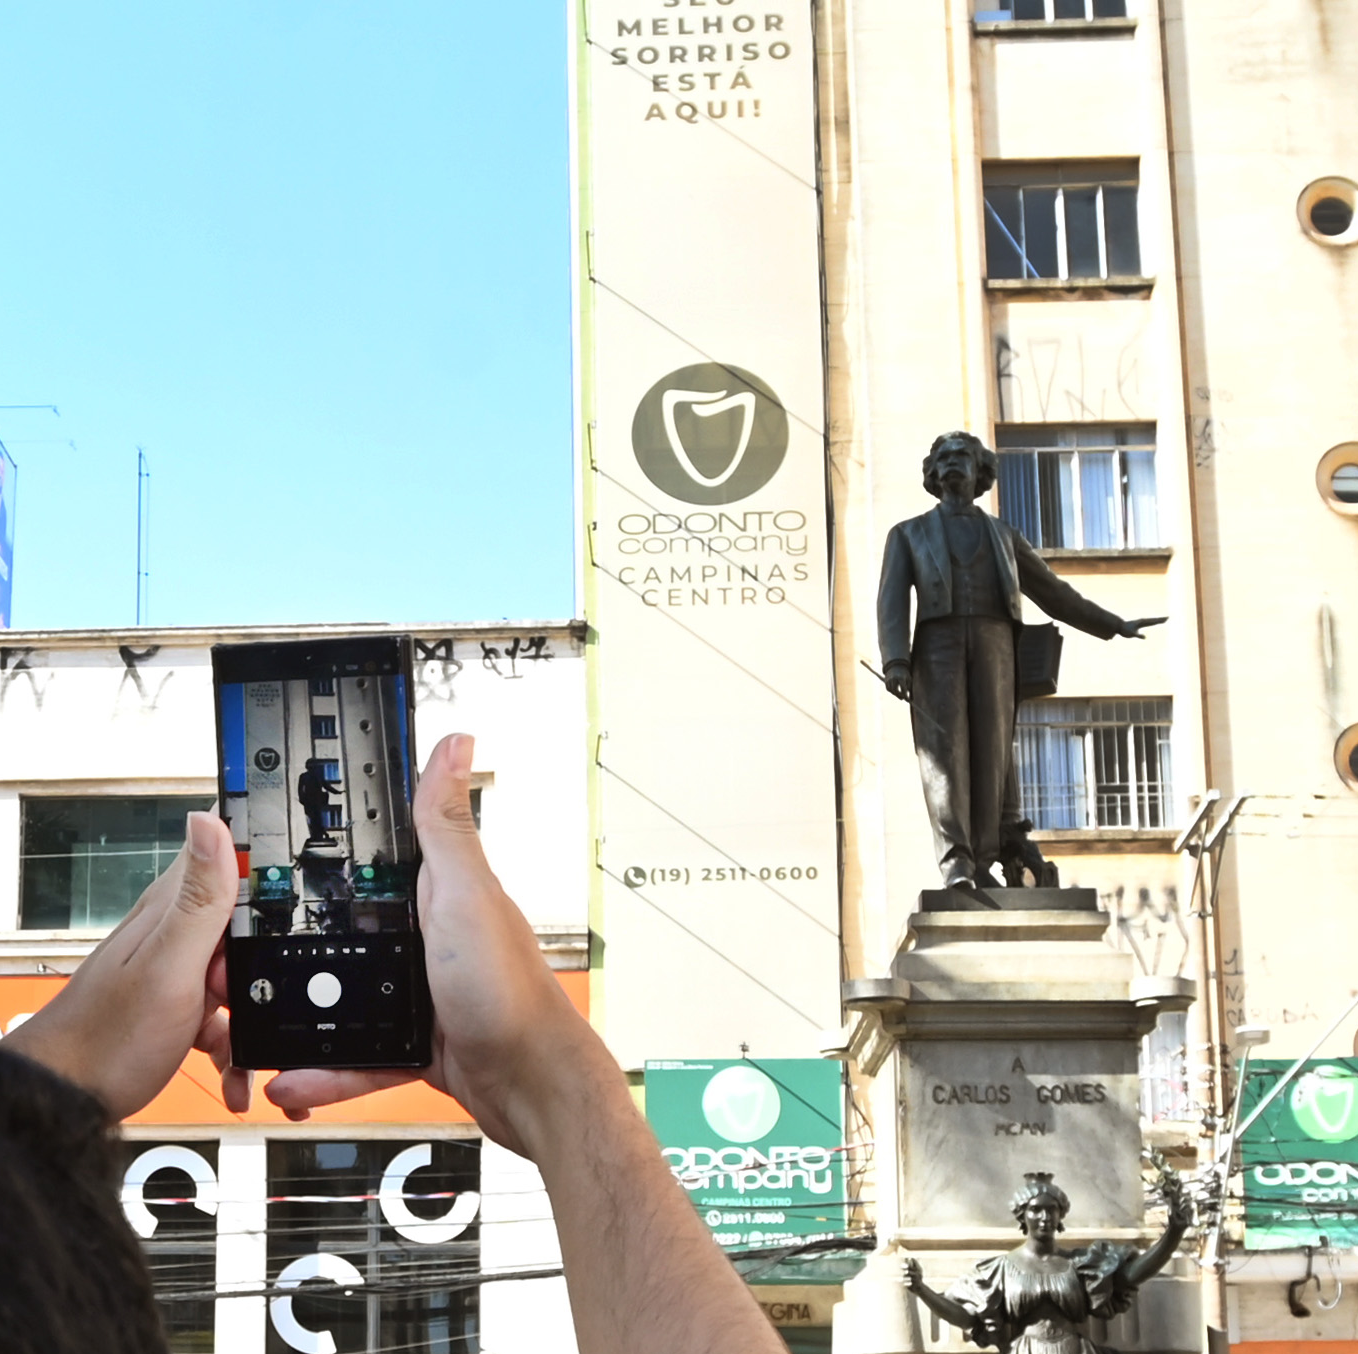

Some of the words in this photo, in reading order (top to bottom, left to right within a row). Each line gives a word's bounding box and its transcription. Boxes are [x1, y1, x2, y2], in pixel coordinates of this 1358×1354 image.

[617, 14, 784, 37] MELHOR
[610, 41, 792, 66] SORRISO
[652, 66, 753, 92] ESTÁ
[644, 99, 762, 124] AQUI!
[618, 509, 807, 535] ODONTO
[618, 534, 808, 557] company
[618, 562, 809, 585] CAMPINAS
[642, 586, 785, 606] CENTRO
[650, 867, 691, 886] (19)
[701, 866, 819, 881] 2511-0600
[1011, 1056, 1025, 1073] A
[932, 1084, 1012, 1104] CARLOS
[1036, 1083, 1107, 1104] GOMES
